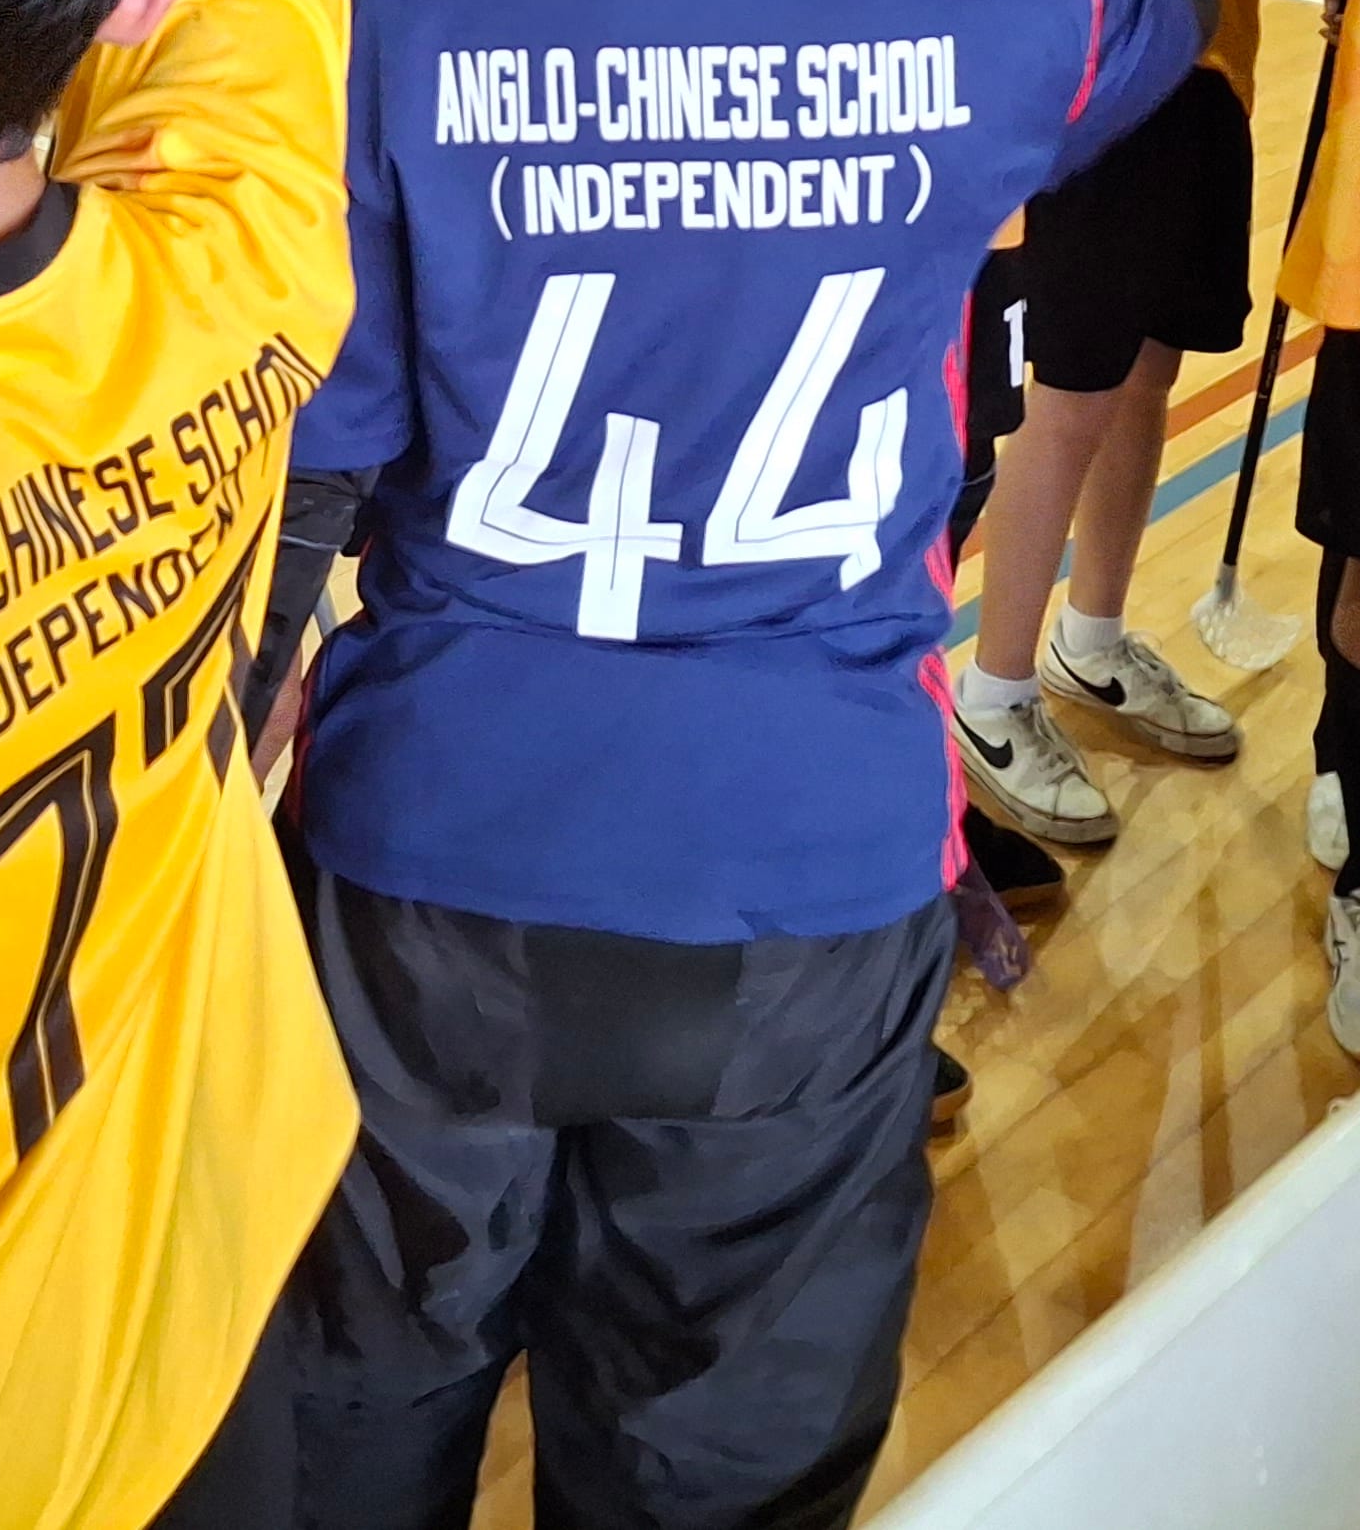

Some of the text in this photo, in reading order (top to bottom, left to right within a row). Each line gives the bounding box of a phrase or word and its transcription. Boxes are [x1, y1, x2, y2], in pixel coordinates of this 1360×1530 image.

[436, 34, 972, 145] ANGLO-CHINESE SCHOOL
[445, 265, 909, 641] 44
